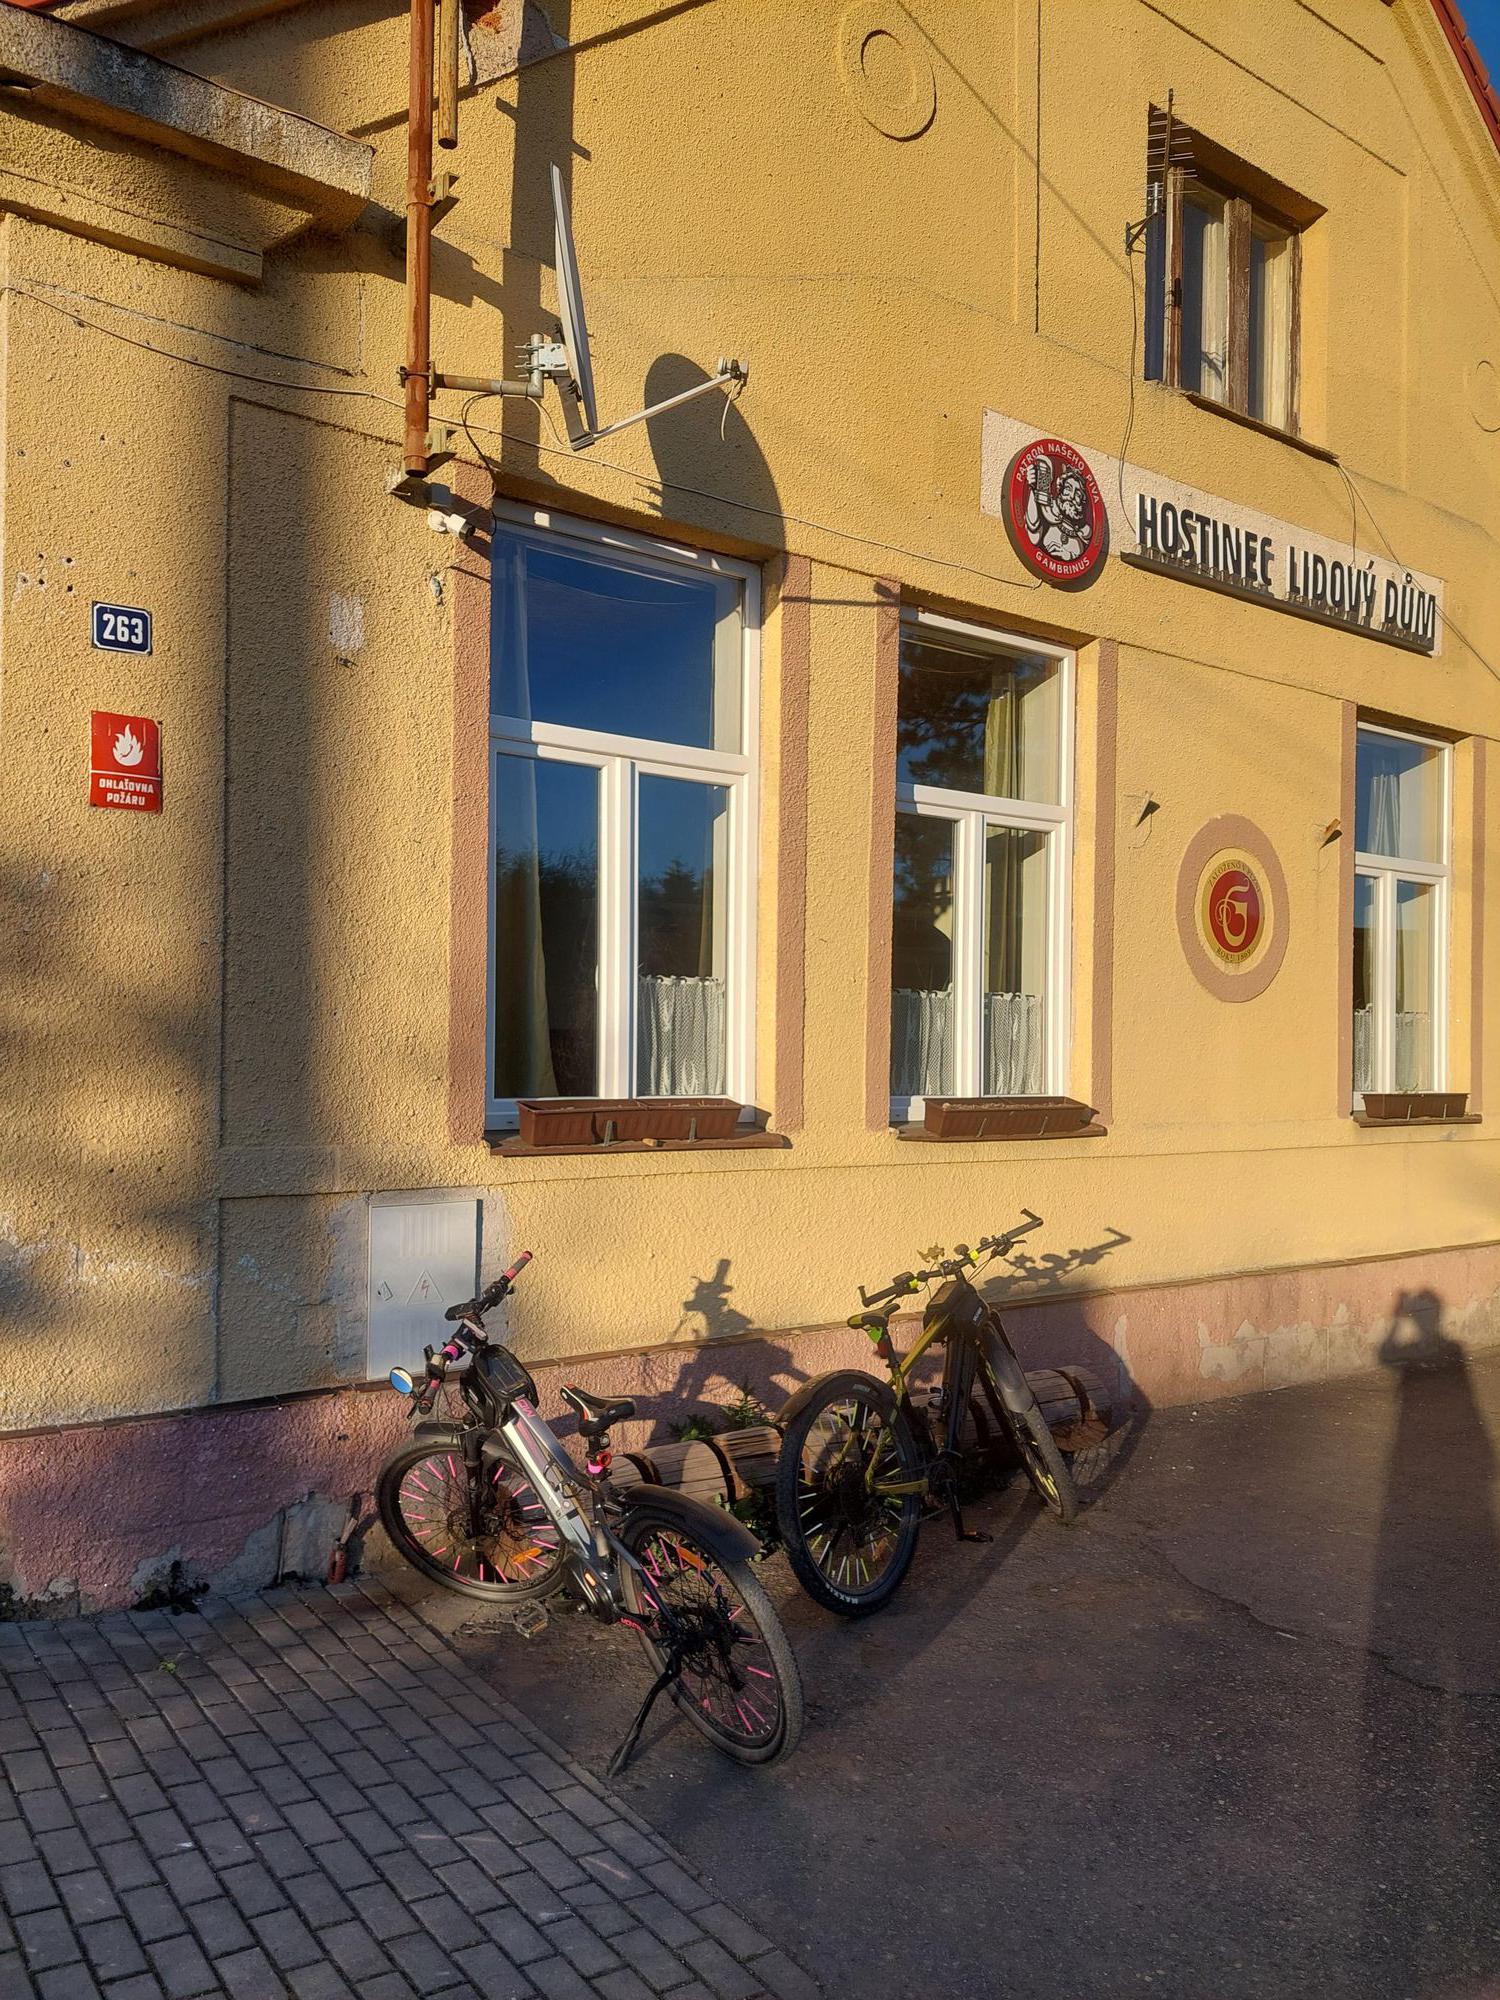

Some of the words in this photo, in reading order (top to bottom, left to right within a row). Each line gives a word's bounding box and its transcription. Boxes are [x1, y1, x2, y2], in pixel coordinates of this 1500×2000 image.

[1016, 444, 1044, 482] PATRON
[1048, 443, 1085, 471] NAŠEHO
[1086, 474, 1100, 503] PIVA
[1035, 551, 1090, 575] GAMBRINUS
[1136, 493, 1272, 586] HOSTINEC
[1286, 545, 1377, 617] LIDOVÝ
[1382, 572, 1436, 639] DŮM
[102, 613, 144, 645] 263
[99, 777, 154, 794] OHLAŠOVNA
[107, 790, 146, 806] POŽÁRU
